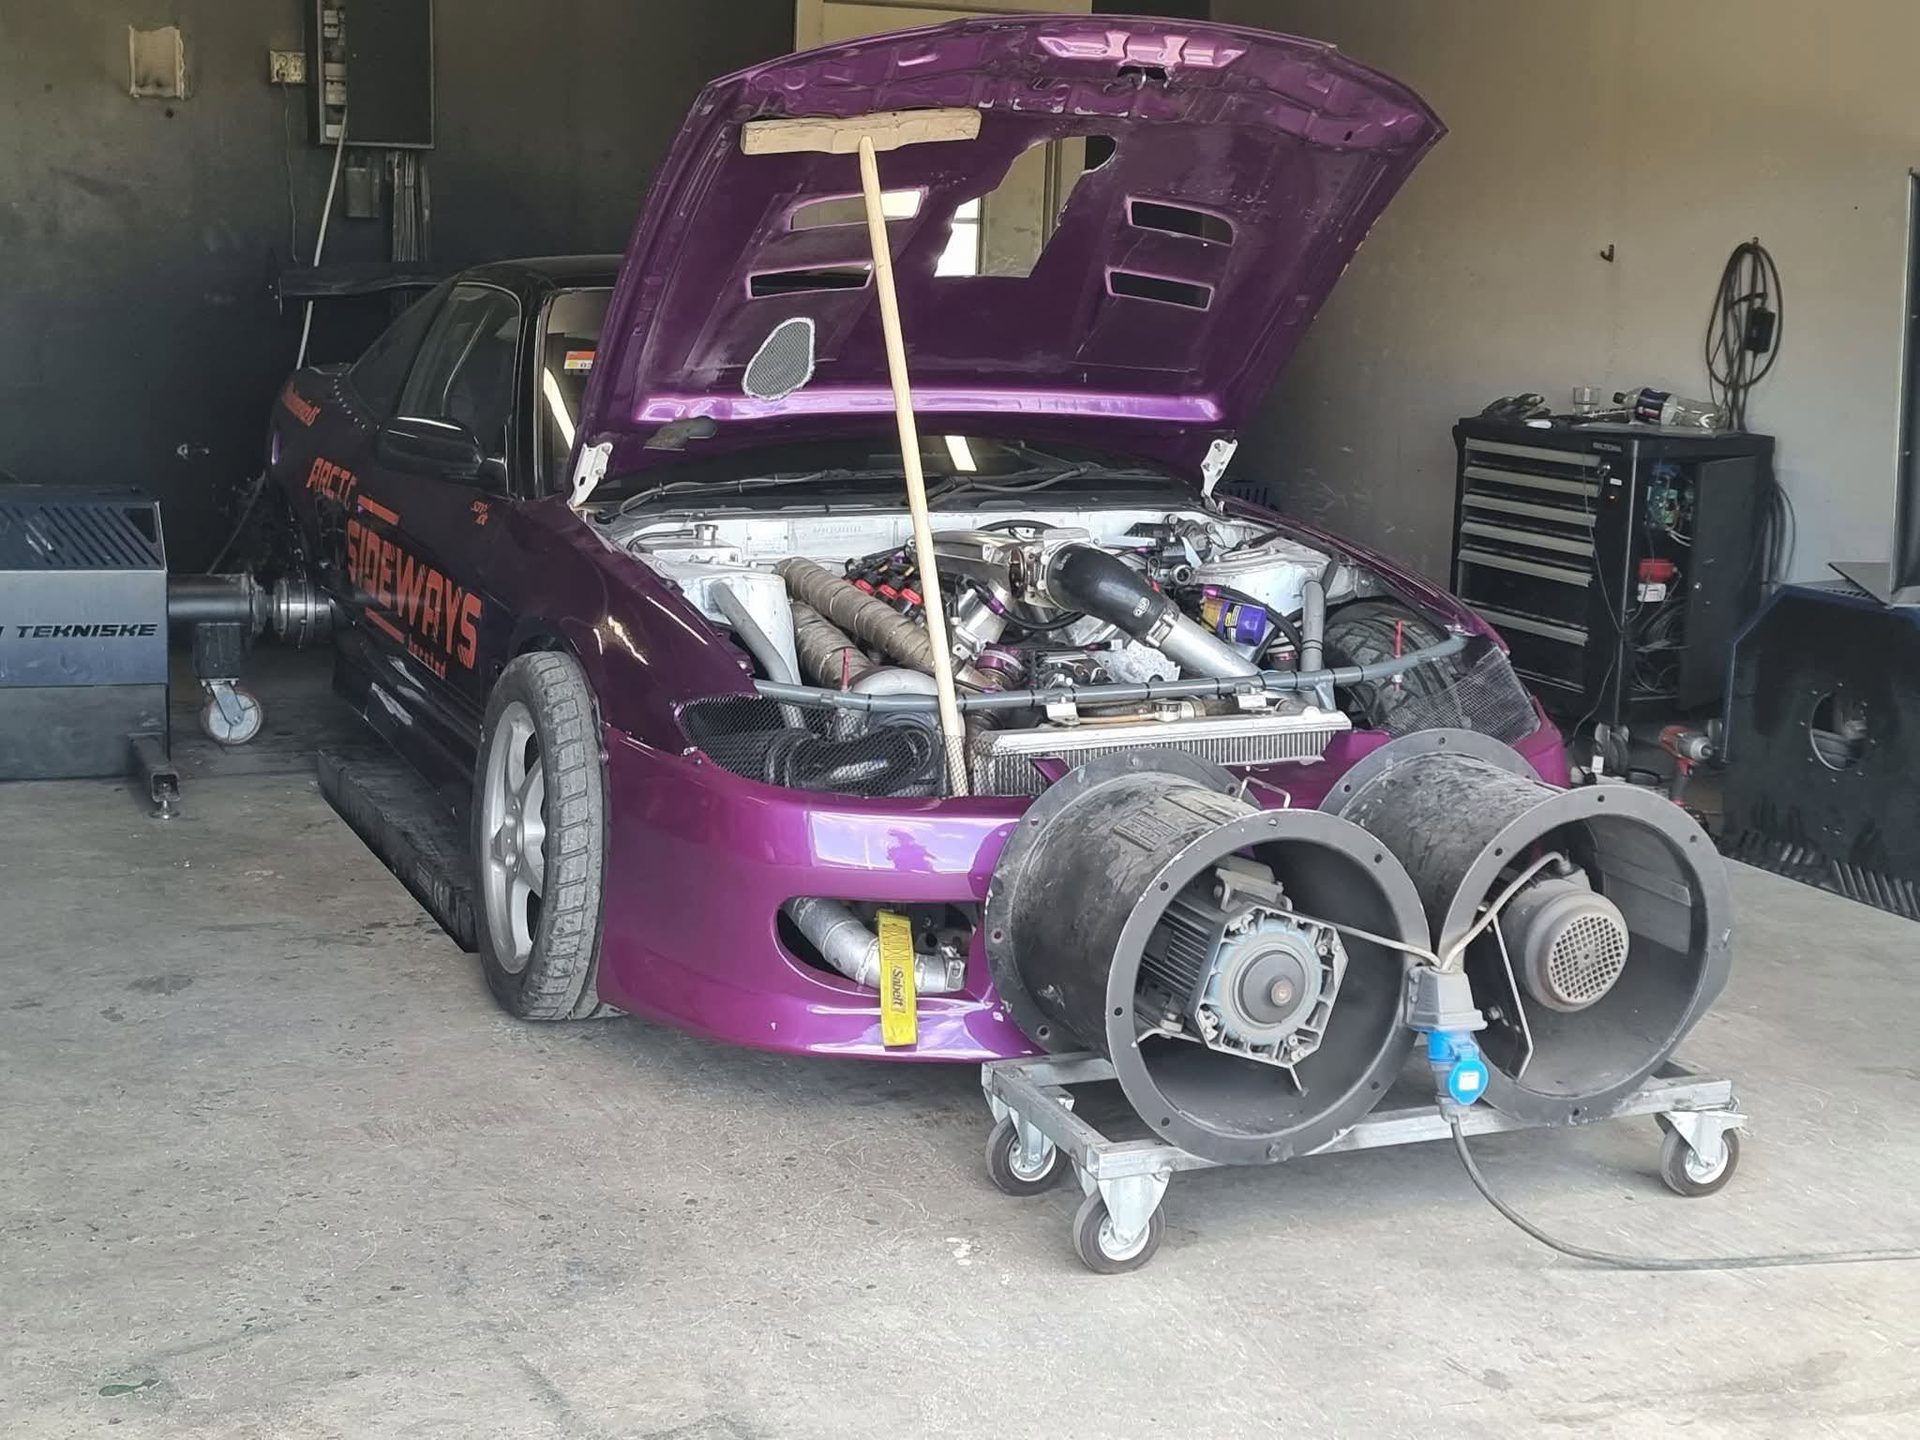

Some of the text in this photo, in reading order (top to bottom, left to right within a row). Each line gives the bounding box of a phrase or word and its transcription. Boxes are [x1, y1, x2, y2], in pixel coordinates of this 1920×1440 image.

[347, 519, 481, 669] SIDEWAYS
[16, 623, 158, 638] TEKNISKE
[892, 968, 904, 1007] Sabelt
